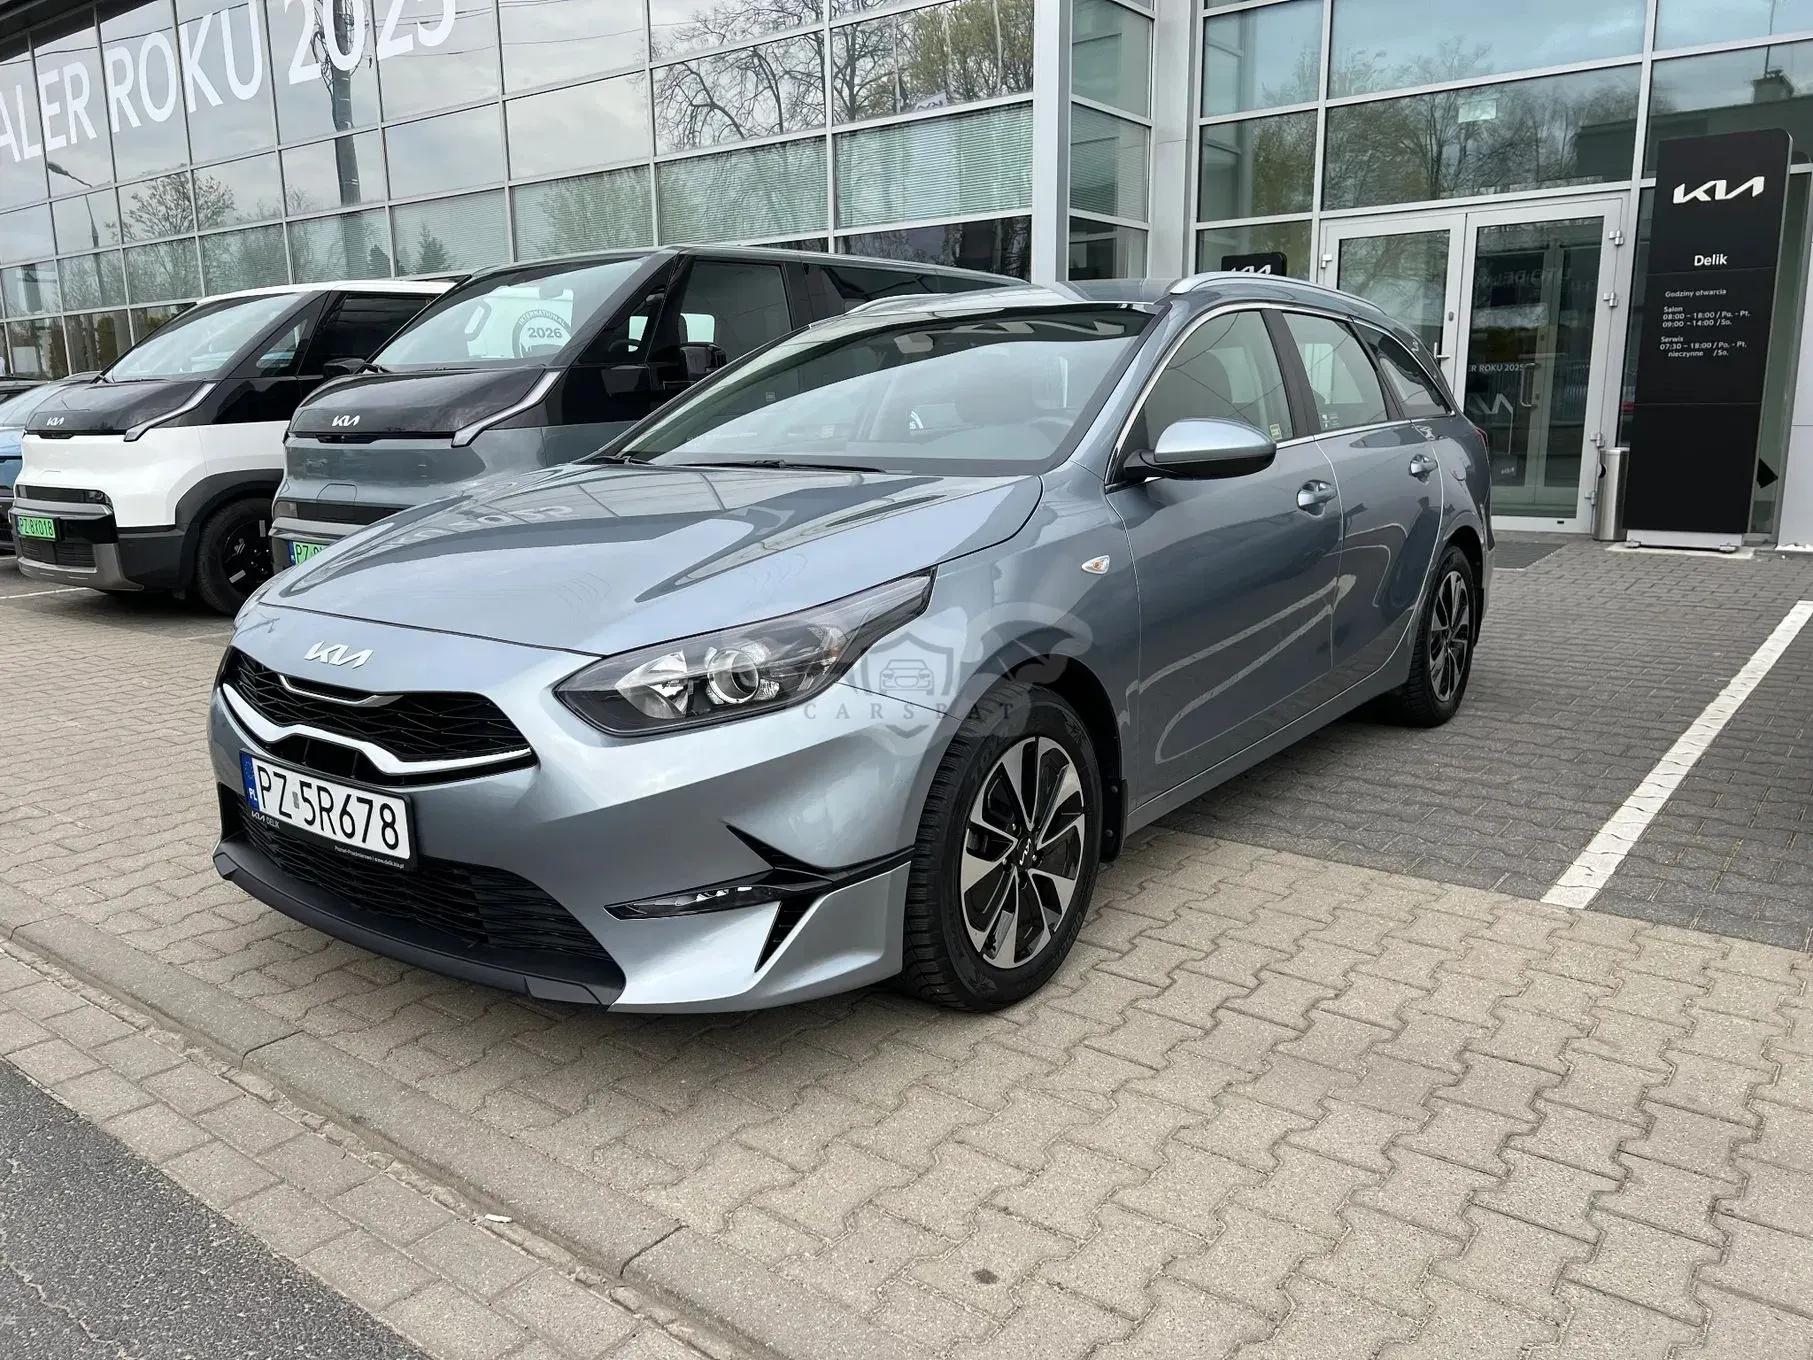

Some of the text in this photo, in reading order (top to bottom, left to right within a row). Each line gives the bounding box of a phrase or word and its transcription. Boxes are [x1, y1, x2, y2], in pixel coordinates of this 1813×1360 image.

[0, 61, 98, 163] ALER
[104, 0, 263, 134] ROKU
[1672, 176, 1765, 204] KIA
[1693, 253, 1728, 266] Delik
[1664, 288, 1727, 298] Godziny otwarcia
[527, 327, 563, 339] 2026
[1668, 350, 1704, 358] nieczynne
[331, 415, 360, 427] KIA
[303, 640, 374, 669] KIA
[257, 765, 399, 850] PZ 5R678
